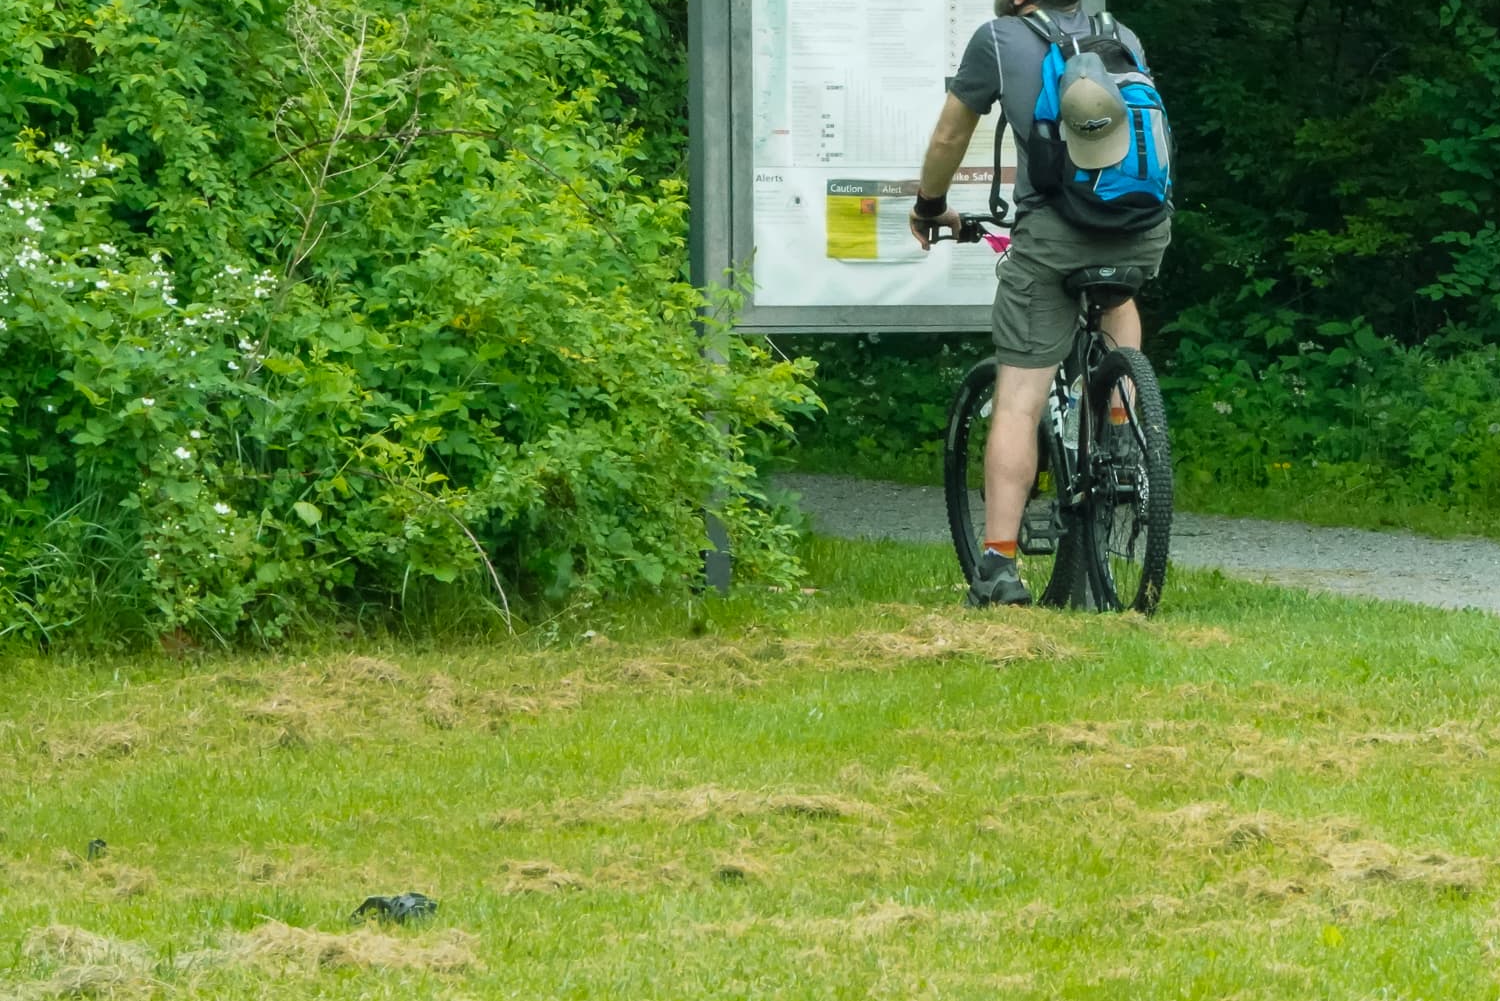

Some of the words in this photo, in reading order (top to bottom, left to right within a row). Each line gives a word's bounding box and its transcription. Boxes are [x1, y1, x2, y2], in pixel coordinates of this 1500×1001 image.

[756, 174, 784, 183] Alerts
[954, 172, 970, 181] ike
[830, 183, 863, 193] Caution
[882, 186, 901, 194] Alert
